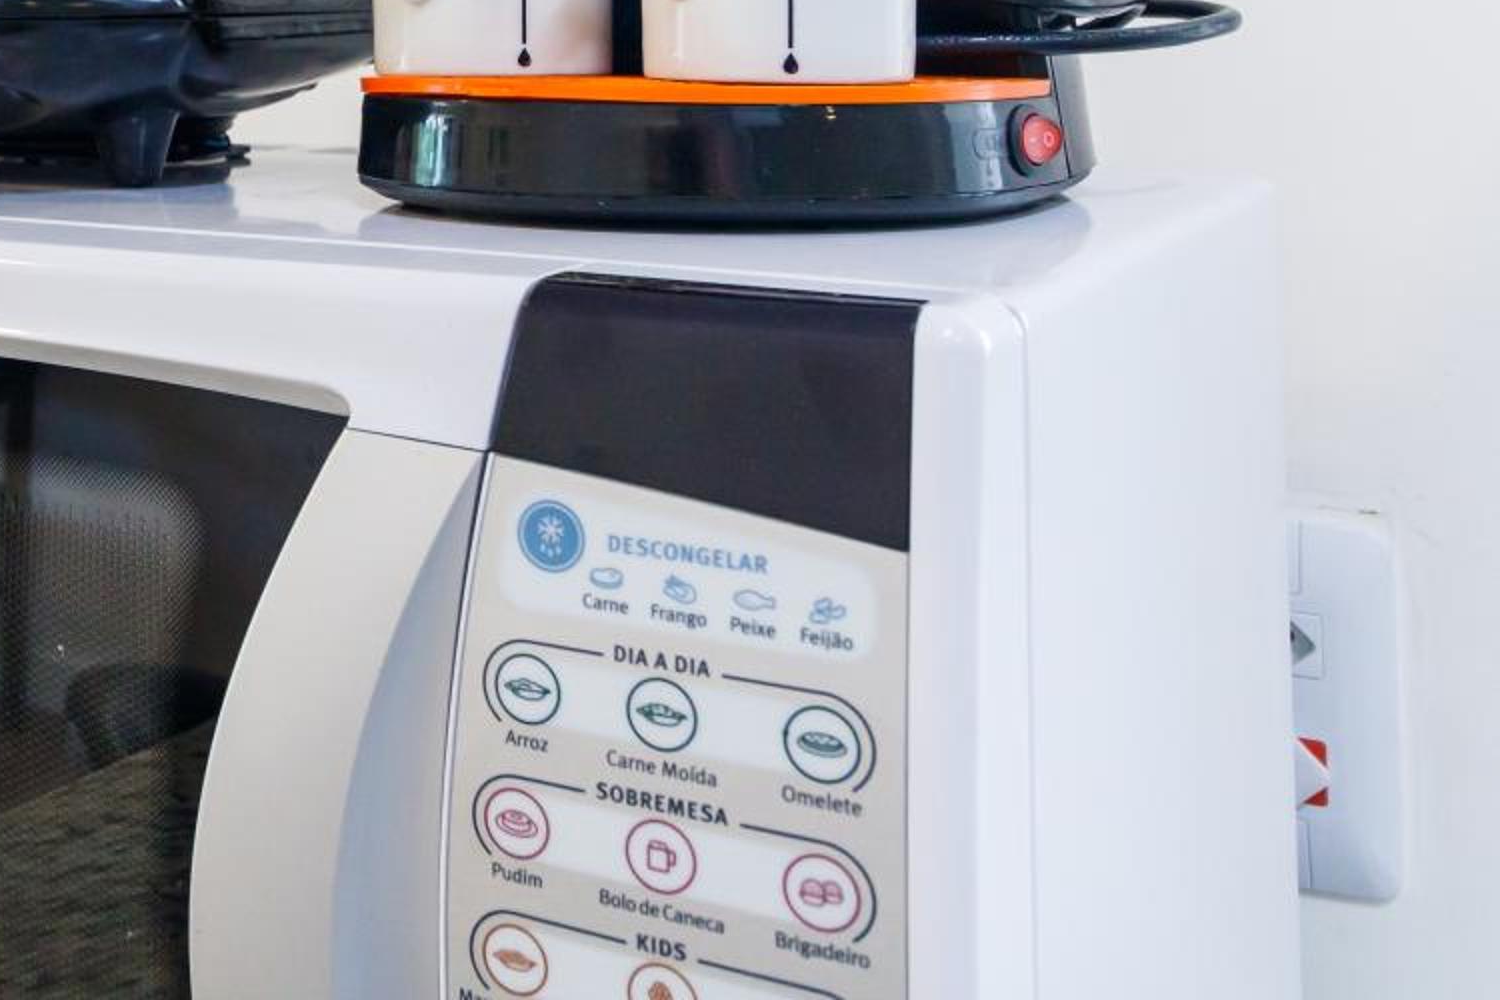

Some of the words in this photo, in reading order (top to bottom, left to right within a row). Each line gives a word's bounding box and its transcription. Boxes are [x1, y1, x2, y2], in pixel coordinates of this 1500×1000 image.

[607, 534, 769, 575] DESCONGELAR
[581, 592, 629, 616] Carne
[650, 603, 707, 629] Frango
[729, 615, 777, 639] Peixe
[800, 626, 855, 652] Feijão
[612, 643, 648, 668] DIA
[653, 652, 669, 671] A
[674, 655, 711, 679] DIA
[505, 729, 549, 753] Arroz
[606, 748, 656, 776] Carne
[662, 761, 718, 788] Moída
[596, 781, 729, 826] SOBREMESA
[781, 784, 864, 818] Omelete
[490, 861, 544, 889] Pudim
[598, 887, 637, 911] Bolo
[638, 898, 661, 918] de
[662, 904, 725, 935] Caneca
[636, 934, 687, 962] KIDS
[774, 930, 872, 970] Brigadeiro
